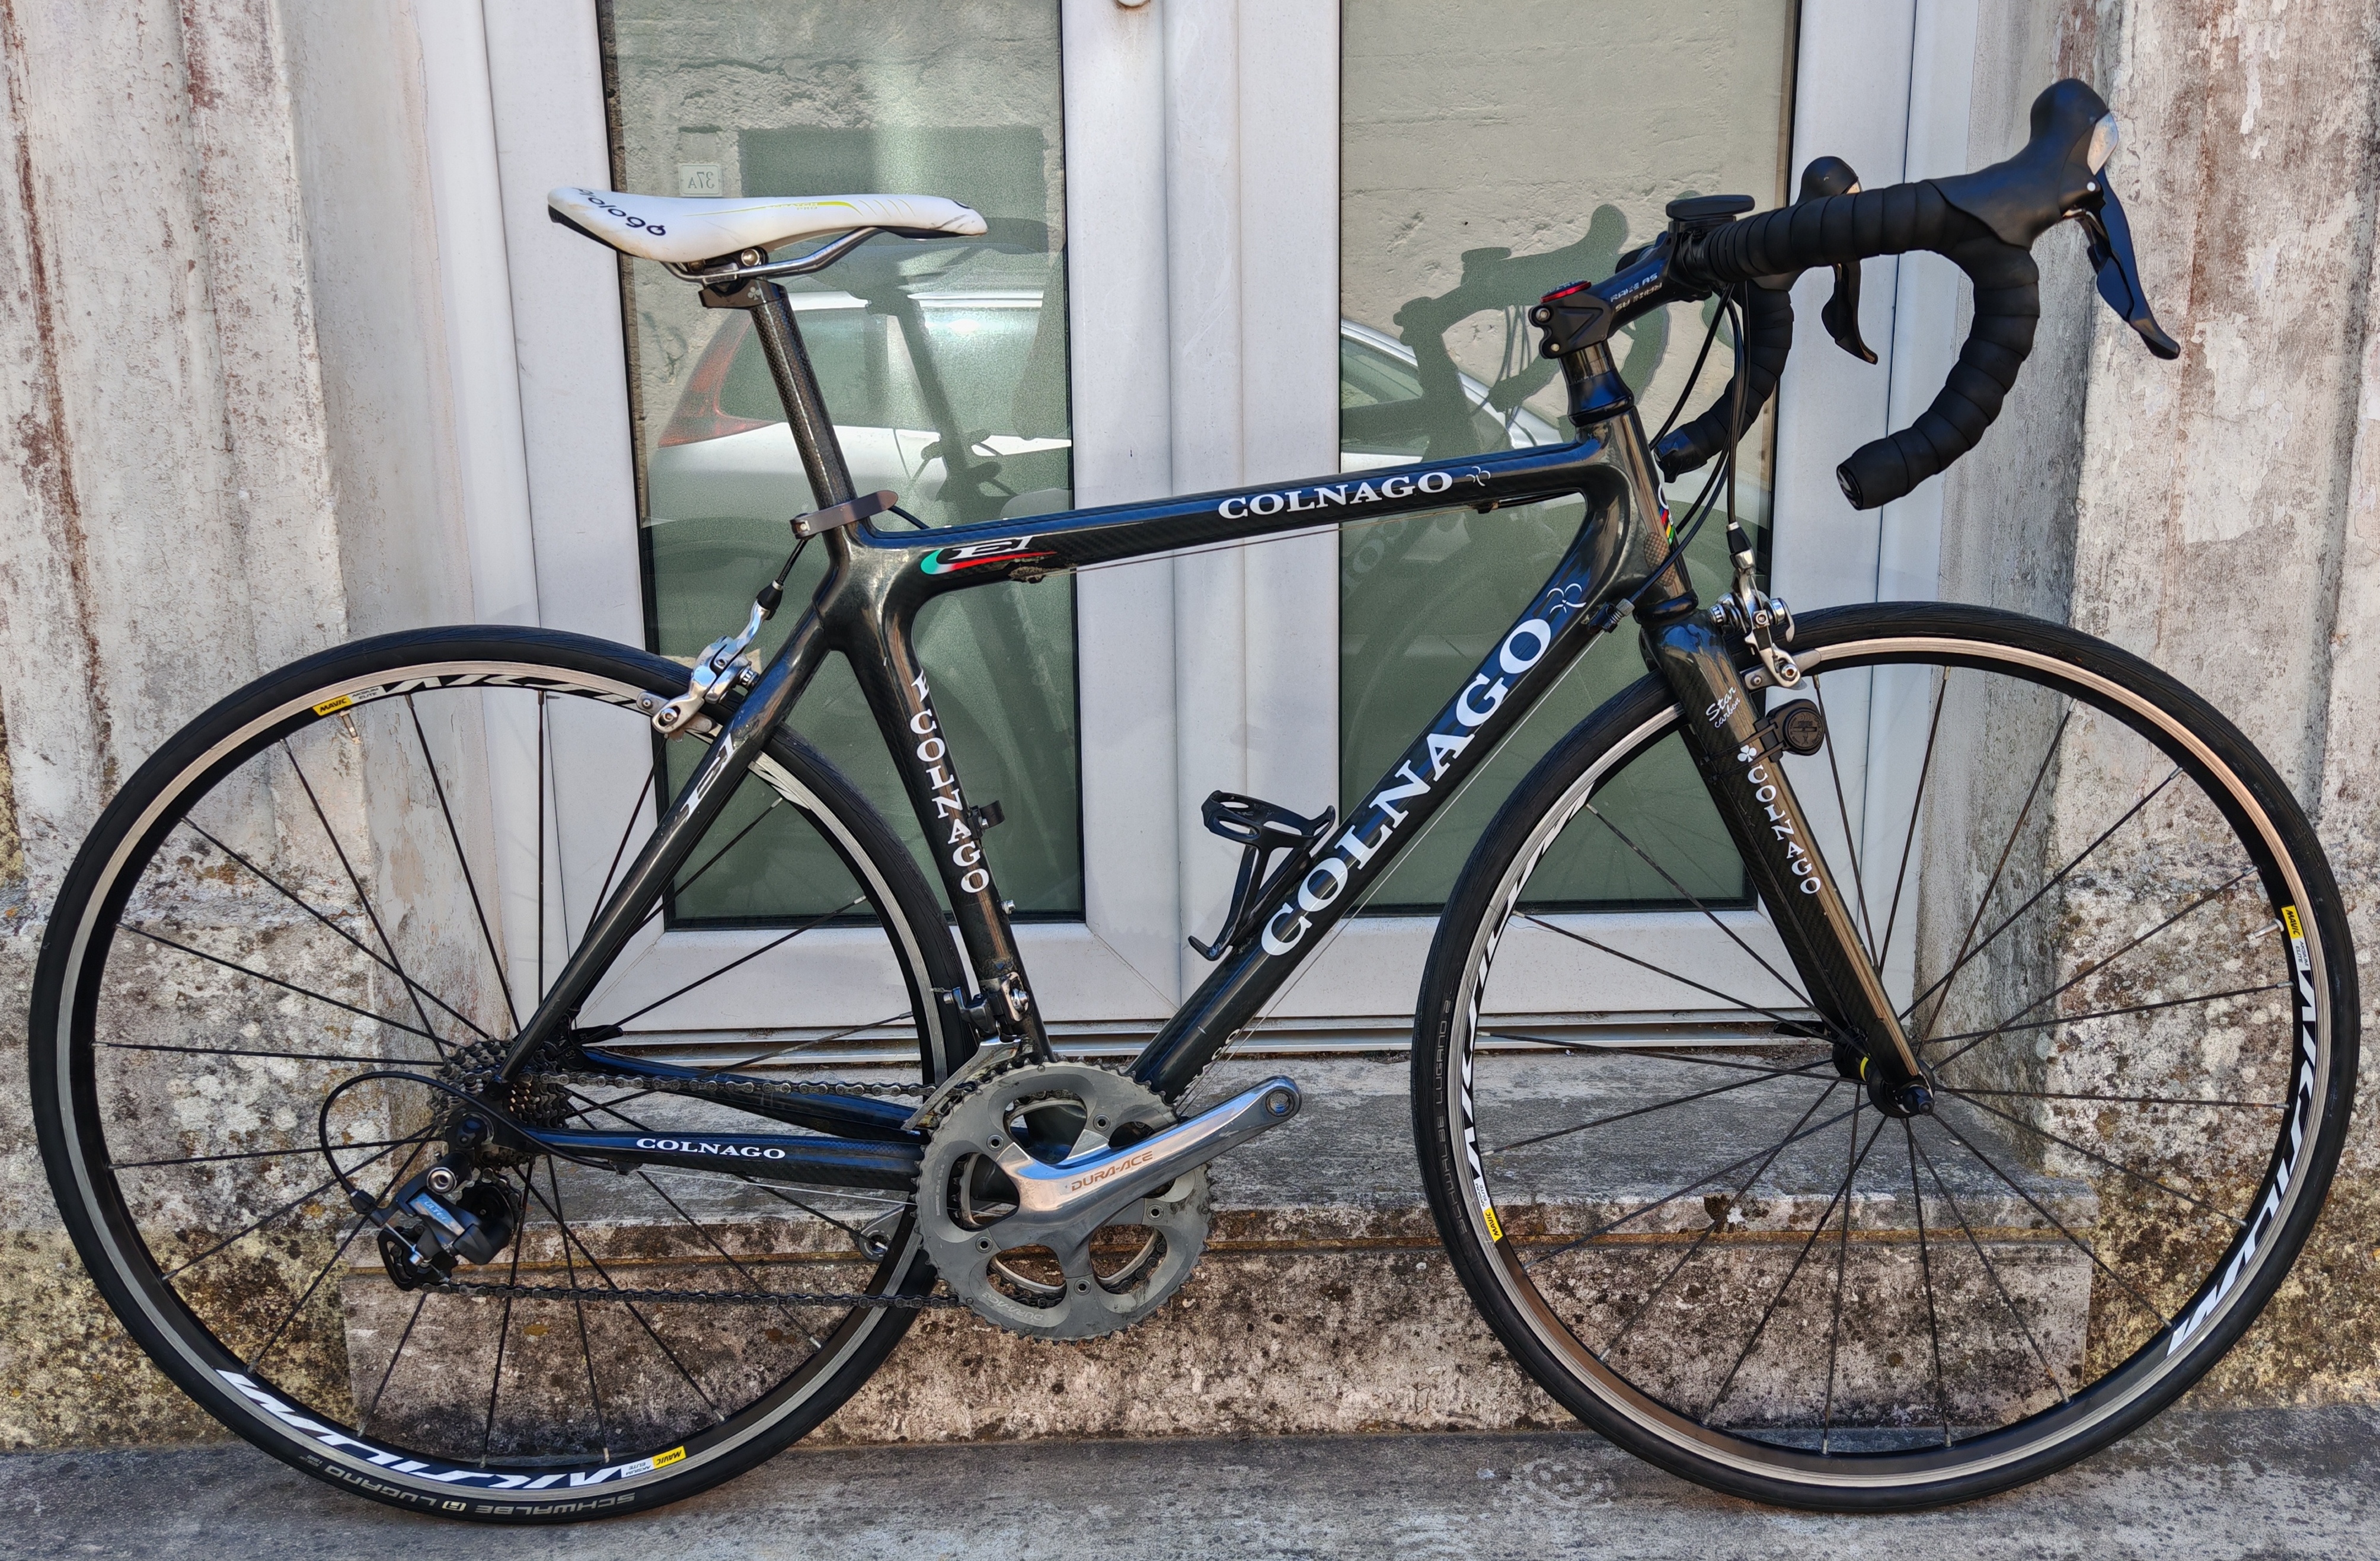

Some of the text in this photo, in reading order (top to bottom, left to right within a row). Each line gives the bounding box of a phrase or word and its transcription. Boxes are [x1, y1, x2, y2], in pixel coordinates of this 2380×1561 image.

[1218, 471, 1453, 519] COLNAGO
[320, 698, 347, 713] MAVIC
[1705, 687, 1736, 722] Star
[910, 709, 989, 893] COLNAGO
[1261, 618, 1551, 956] COLNAGO
[1748, 764, 1822, 895] COLNAGO
[2286, 909, 2301, 937] MAVIC
[1436, 1020, 1448, 1104] LUGANO
[636, 1138, 786, 1160] COLNAGO
[1071, 1151, 1153, 1192] DURA-ACE
[1485, 1211, 1501, 1237] MAVIC
[982, 1291, 1044, 1321] DURA-ACE
[656, 1450, 682, 1466] MAVIC
[324, 1464, 636, 1515] SCHWALBE LUGANO
